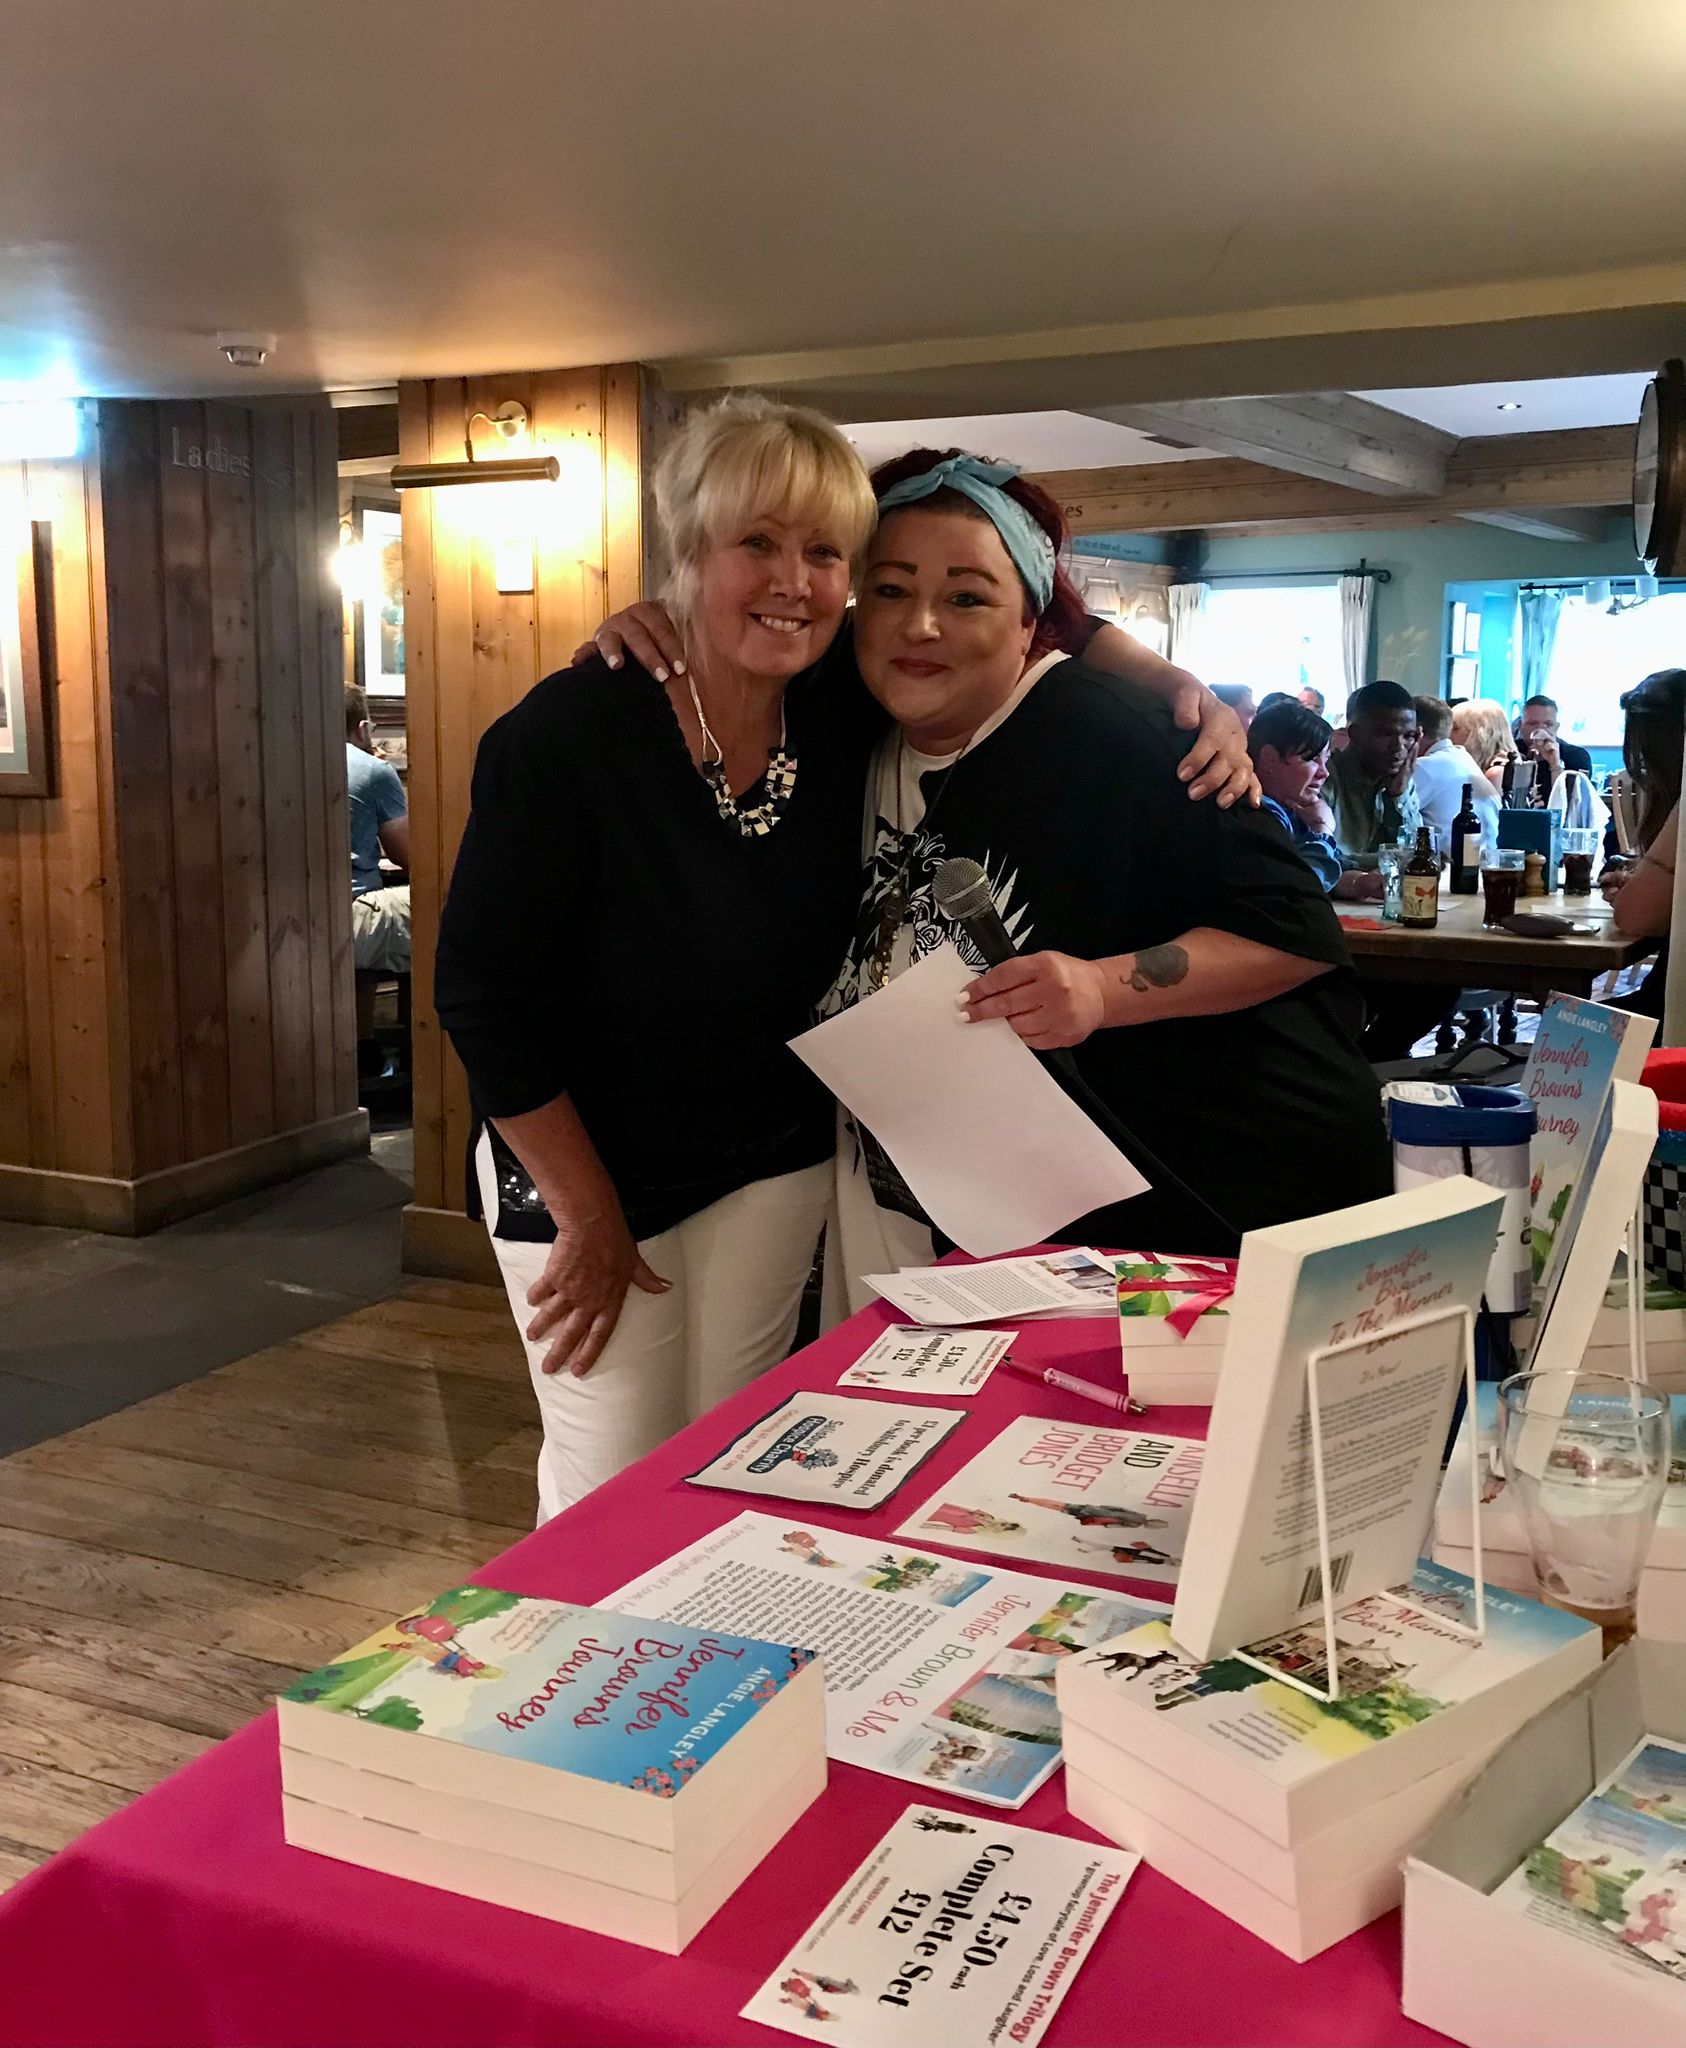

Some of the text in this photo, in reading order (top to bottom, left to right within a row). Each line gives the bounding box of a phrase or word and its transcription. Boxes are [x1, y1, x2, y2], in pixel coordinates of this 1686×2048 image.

[1557, 1009, 1608, 1034] ANGIE LANGLEY
[1532, 1034, 1590, 1074] Jennifer
[1529, 1068, 1582, 1099] Brown's
[1536, 1105, 1580, 1145] urney
[914, 1332, 952, 1366] Complete
[901, 1366, 922, 1377] Set
[750, 1417, 823, 1472] Hospice Charity
[796, 1418, 843, 1451] Salisbury
[858, 1427, 902, 1456] Salisbury
[890, 1439, 920, 1455] book
[909, 1427, 927, 1439] per
[1018, 1426, 1084, 1470] JONES
[1051, 1433, 1130, 1492] BRIDGET
[1123, 1438, 1174, 1469] AND
[832, 1458, 870, 1488] Hospice
[853, 1463, 893, 1495] donated
[1409, 1568, 1441, 1583] GIE
[1340, 1609, 1402, 1637] Born
[1383, 1608, 1481, 1648] Manner
[845, 1594, 1030, 1737] Jennifer Brown & Me
[497, 1638, 624, 1731] Journey
[573, 1638, 683, 1728] Brown's
[624, 1638, 744, 1734] Jennifer
[669, 1667, 770, 1758] ANGIE LANGLEY
[1071, 1866, 1095, 1898] grownup
[878, 1889, 931, 1933] £12
[878, 1844, 1013, 2006] Complete Set
[950, 1891, 1031, 1989] £4.50 each
[1047, 1932, 1057, 1942] of
[1008, 1873, 1120, 2042] The Jennifer Brown Trilogy
[1021, 1964, 1040, 1983] Loss
[1011, 1983, 1026, 2001] and
